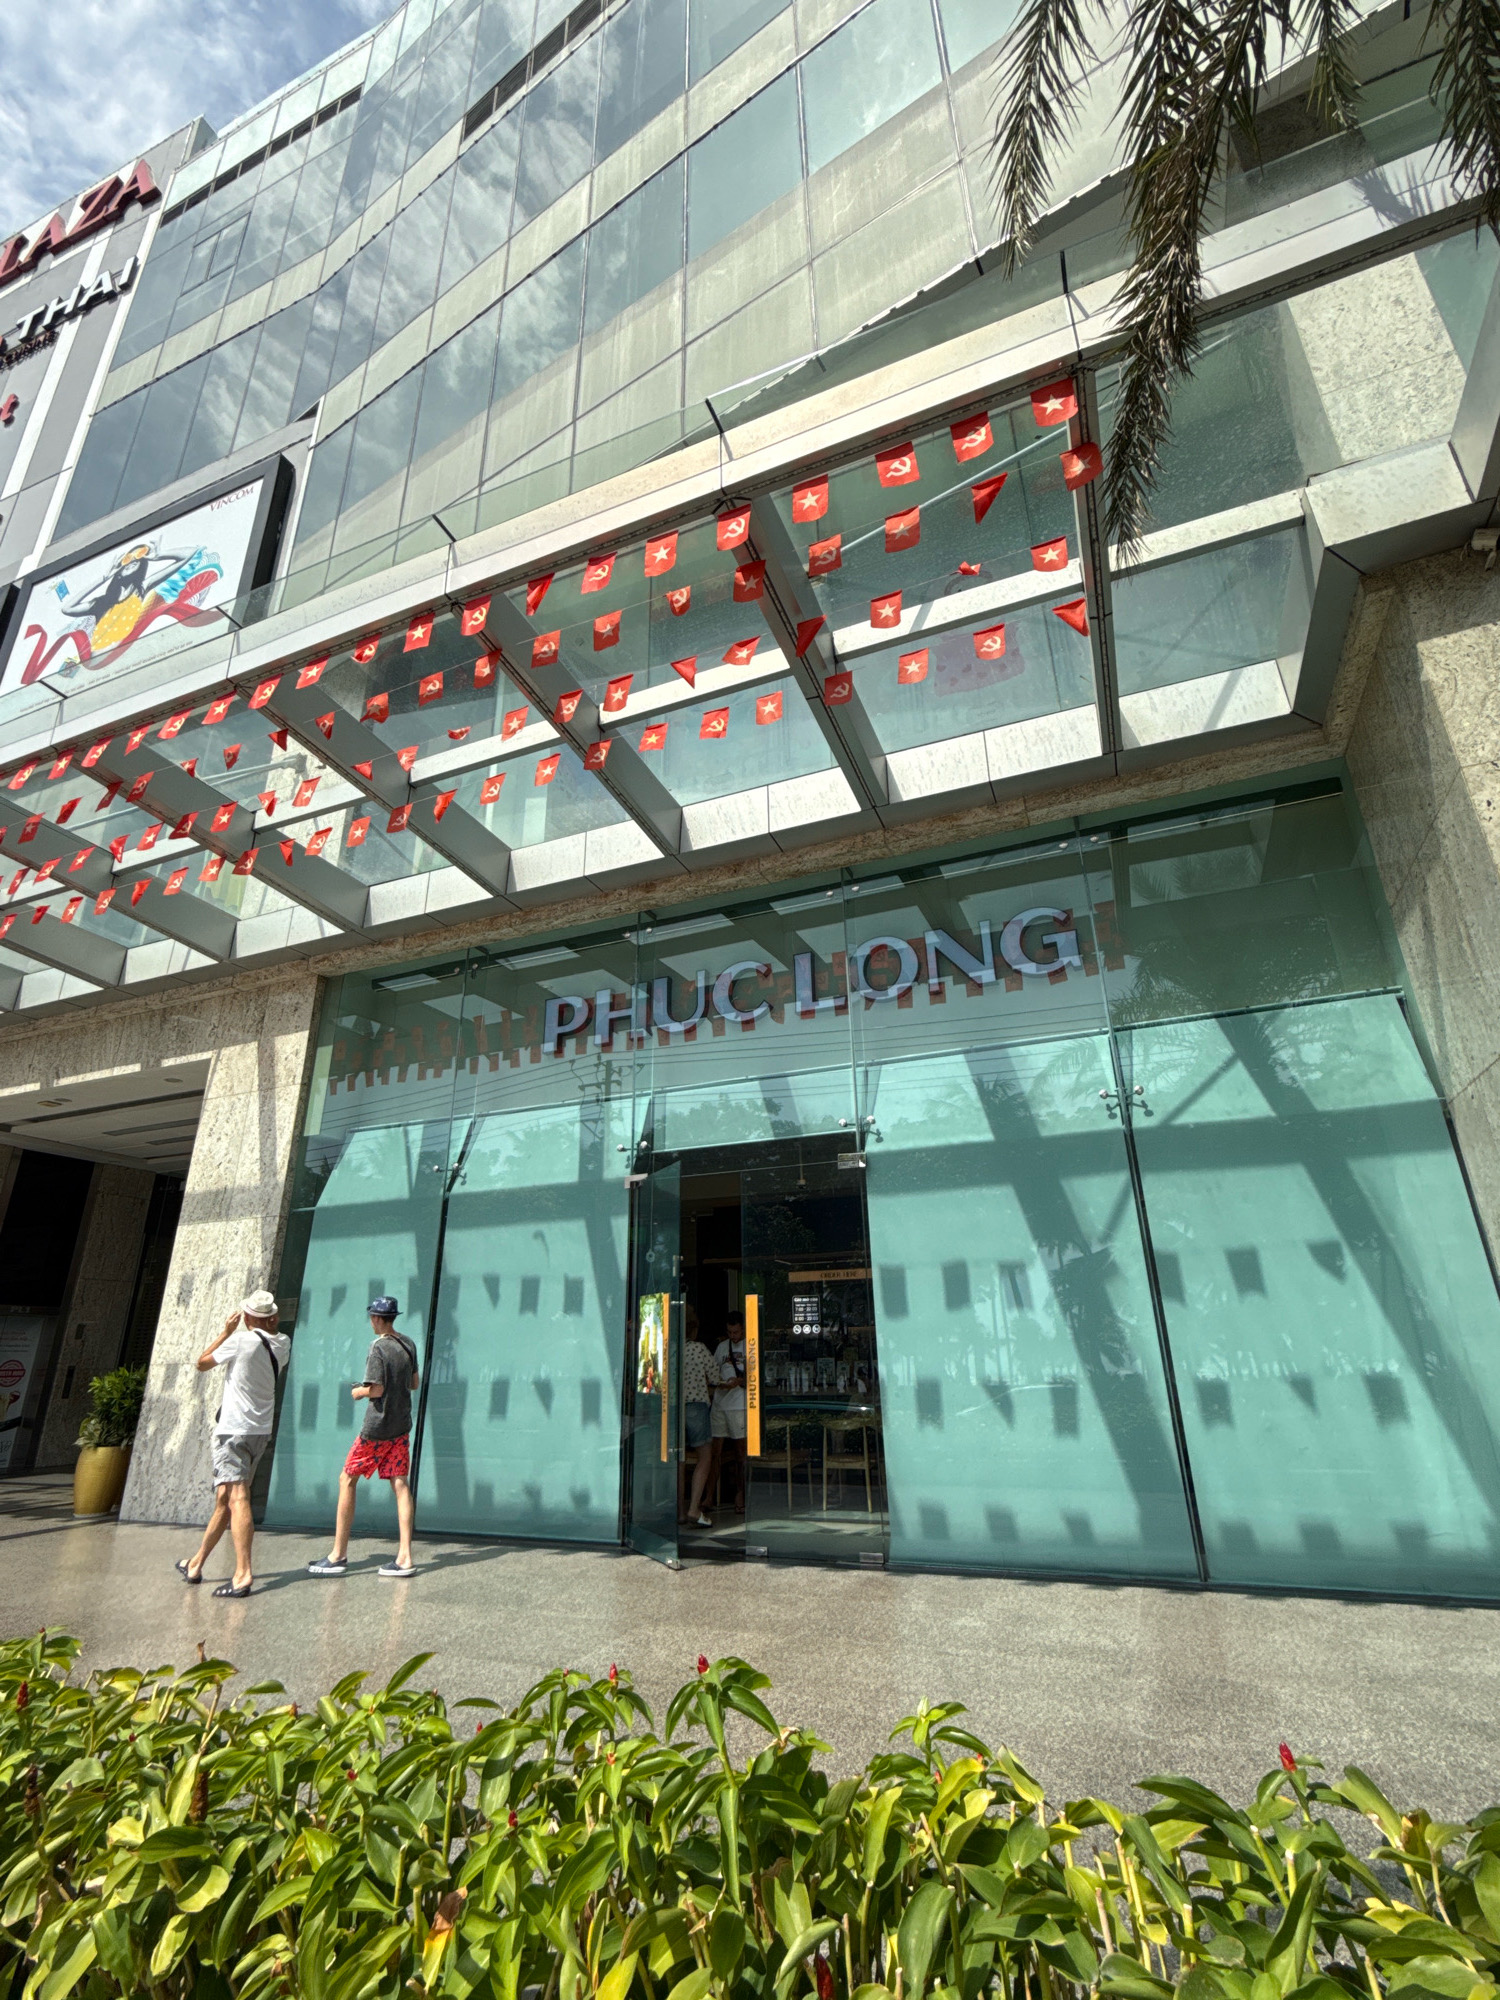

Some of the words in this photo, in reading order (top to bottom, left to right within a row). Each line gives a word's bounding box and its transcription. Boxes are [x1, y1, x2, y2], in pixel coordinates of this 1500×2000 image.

[17, 256, 139, 343] THAI
[210, 486, 254, 511] VINCOM
[543, 960, 773, 1055] PHUC
[793, 907, 1082, 1014] LONG
[748, 1338, 756, 1373] LONG
[748, 1374, 757, 1409] PHUC
